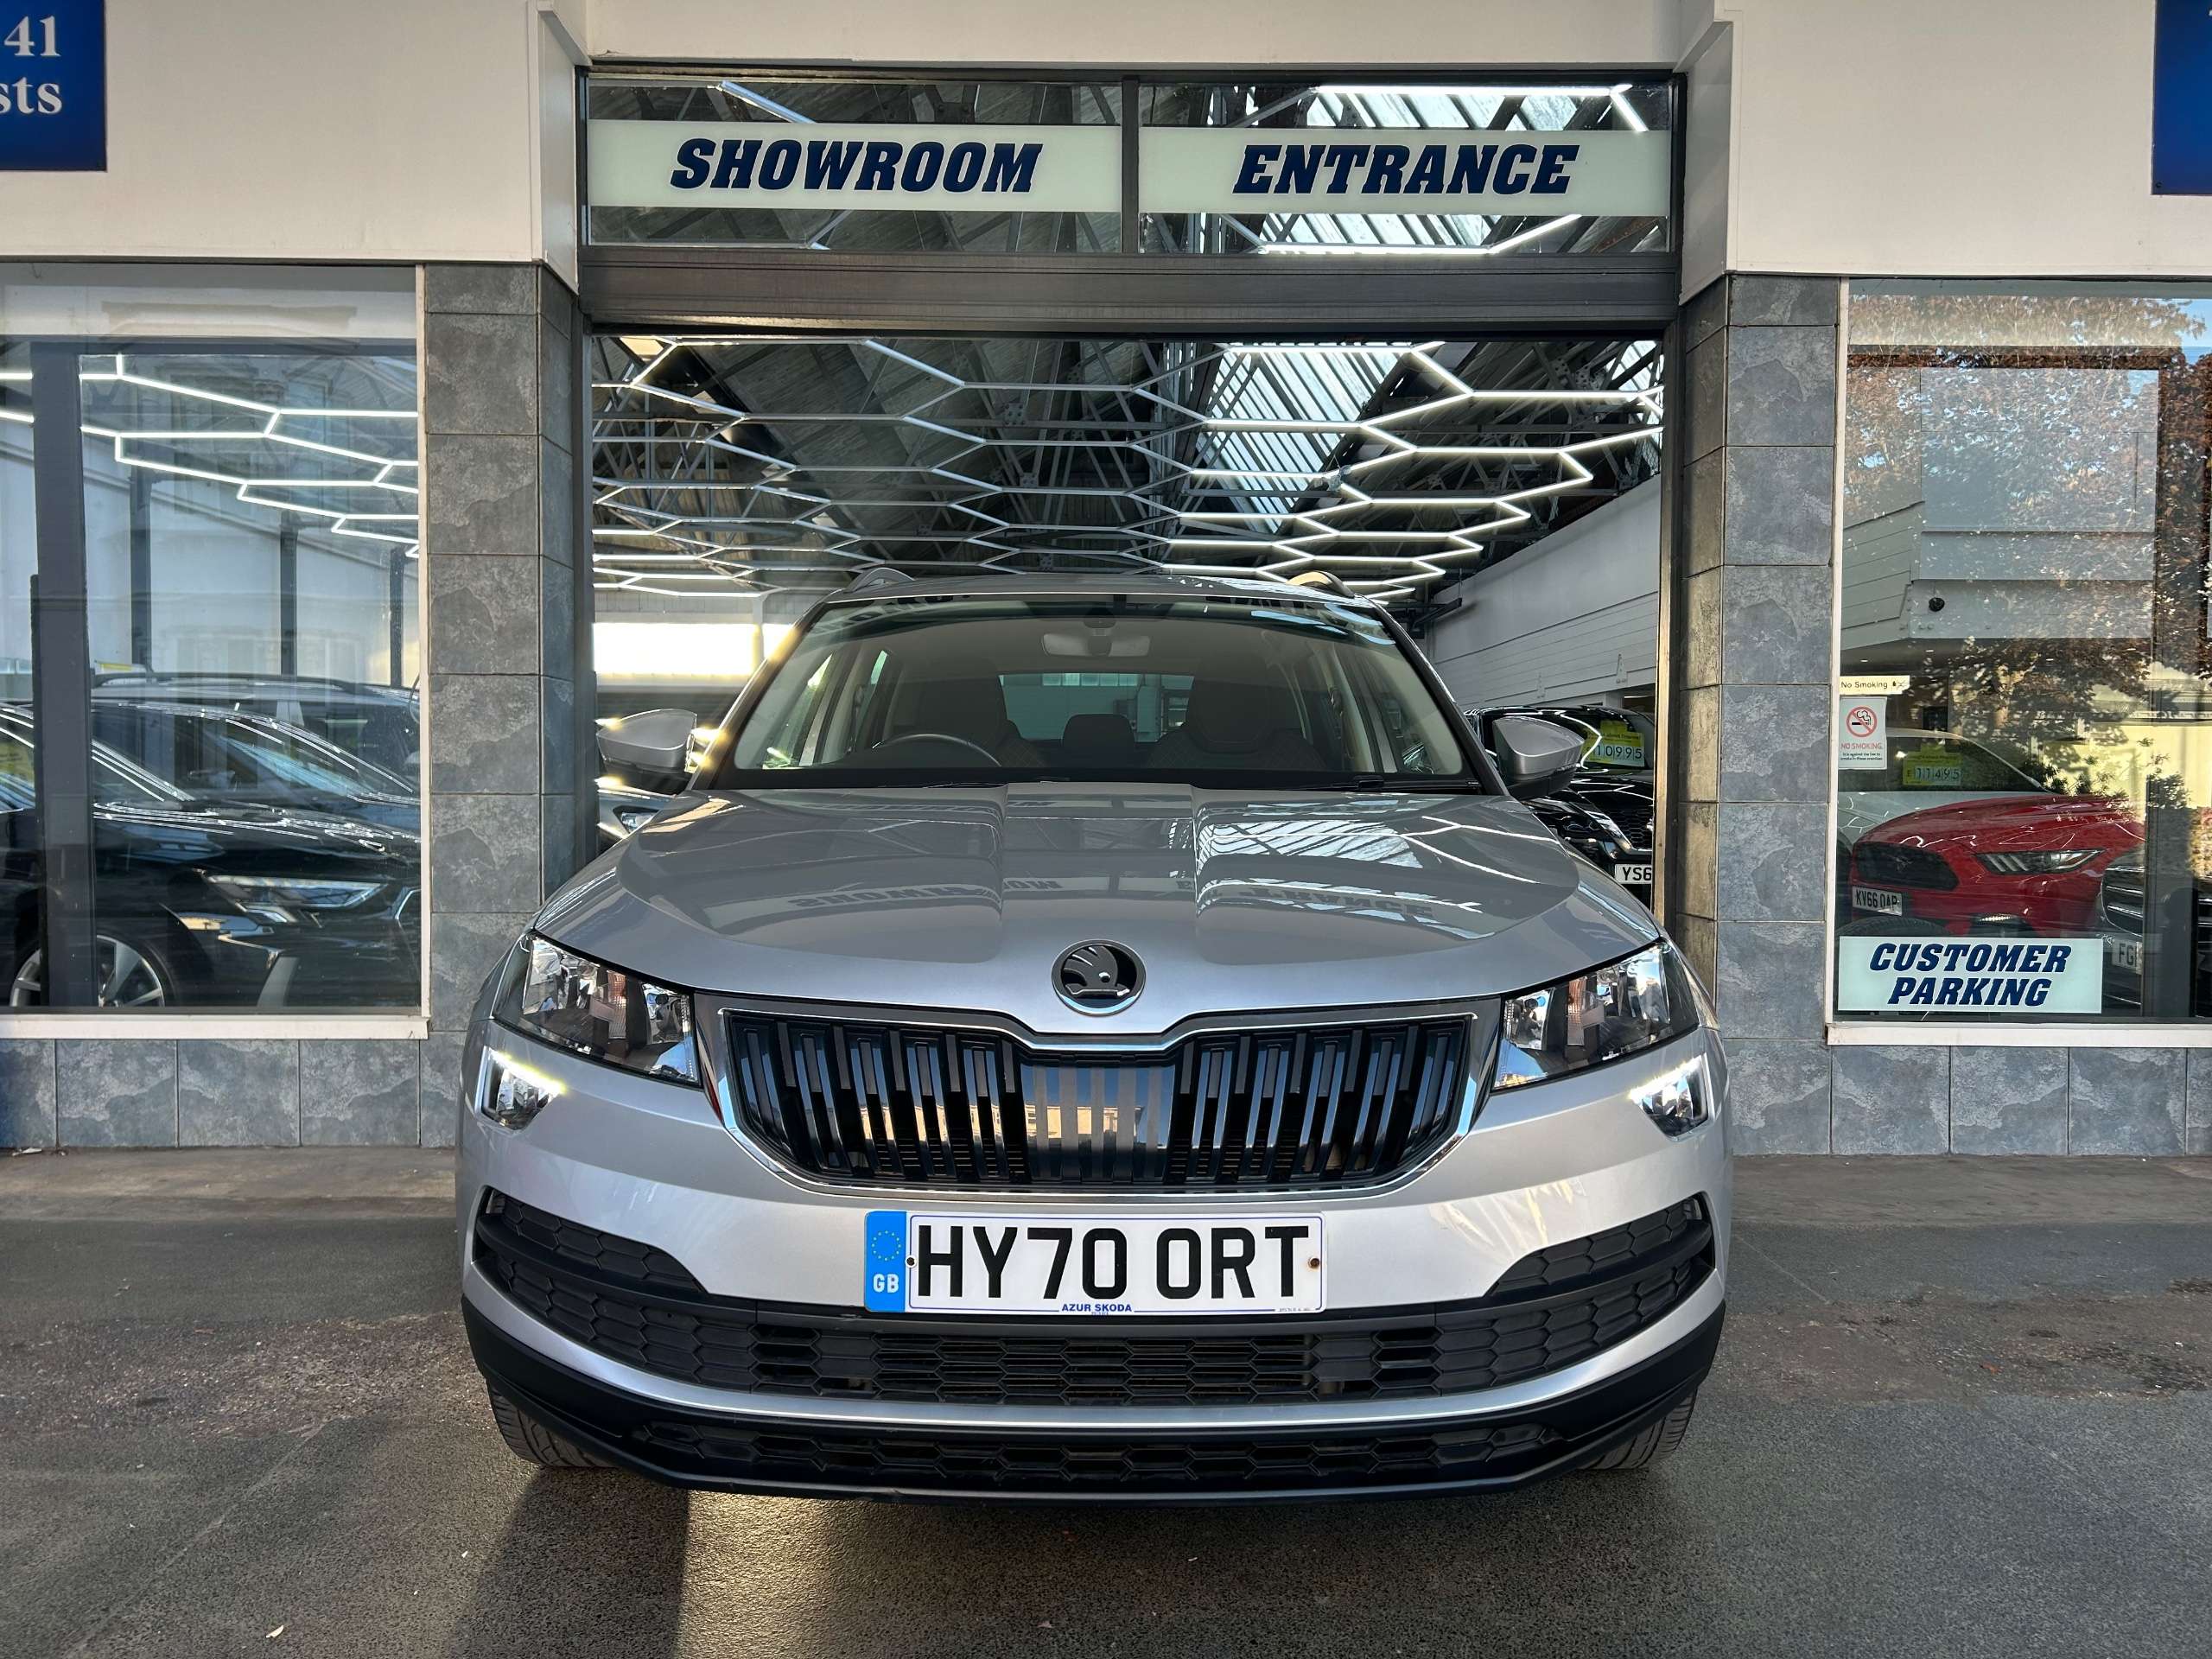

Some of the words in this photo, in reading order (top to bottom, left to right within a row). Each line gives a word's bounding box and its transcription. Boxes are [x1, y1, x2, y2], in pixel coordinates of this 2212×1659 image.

[3, 16, 62, 57] 41
[670, 137, 1044, 193] SHOWROOM
[1232, 143, 1580, 196] ENTRANCE
[1854, 681, 1888, 690] Smoking
[1597, 745, 1643, 760] 10995
[1869, 943, 2072, 973] CUSTOMER
[1887, 976, 2052, 1007] PARKING
[918, 1224, 1128, 1300] HY70
[1155, 1226, 1309, 1300] ORT
[873, 1274, 899, 1294] GB
[1062, 1303, 1091, 1312] AZUR
[1094, 1303, 1132, 1313] SKODA
